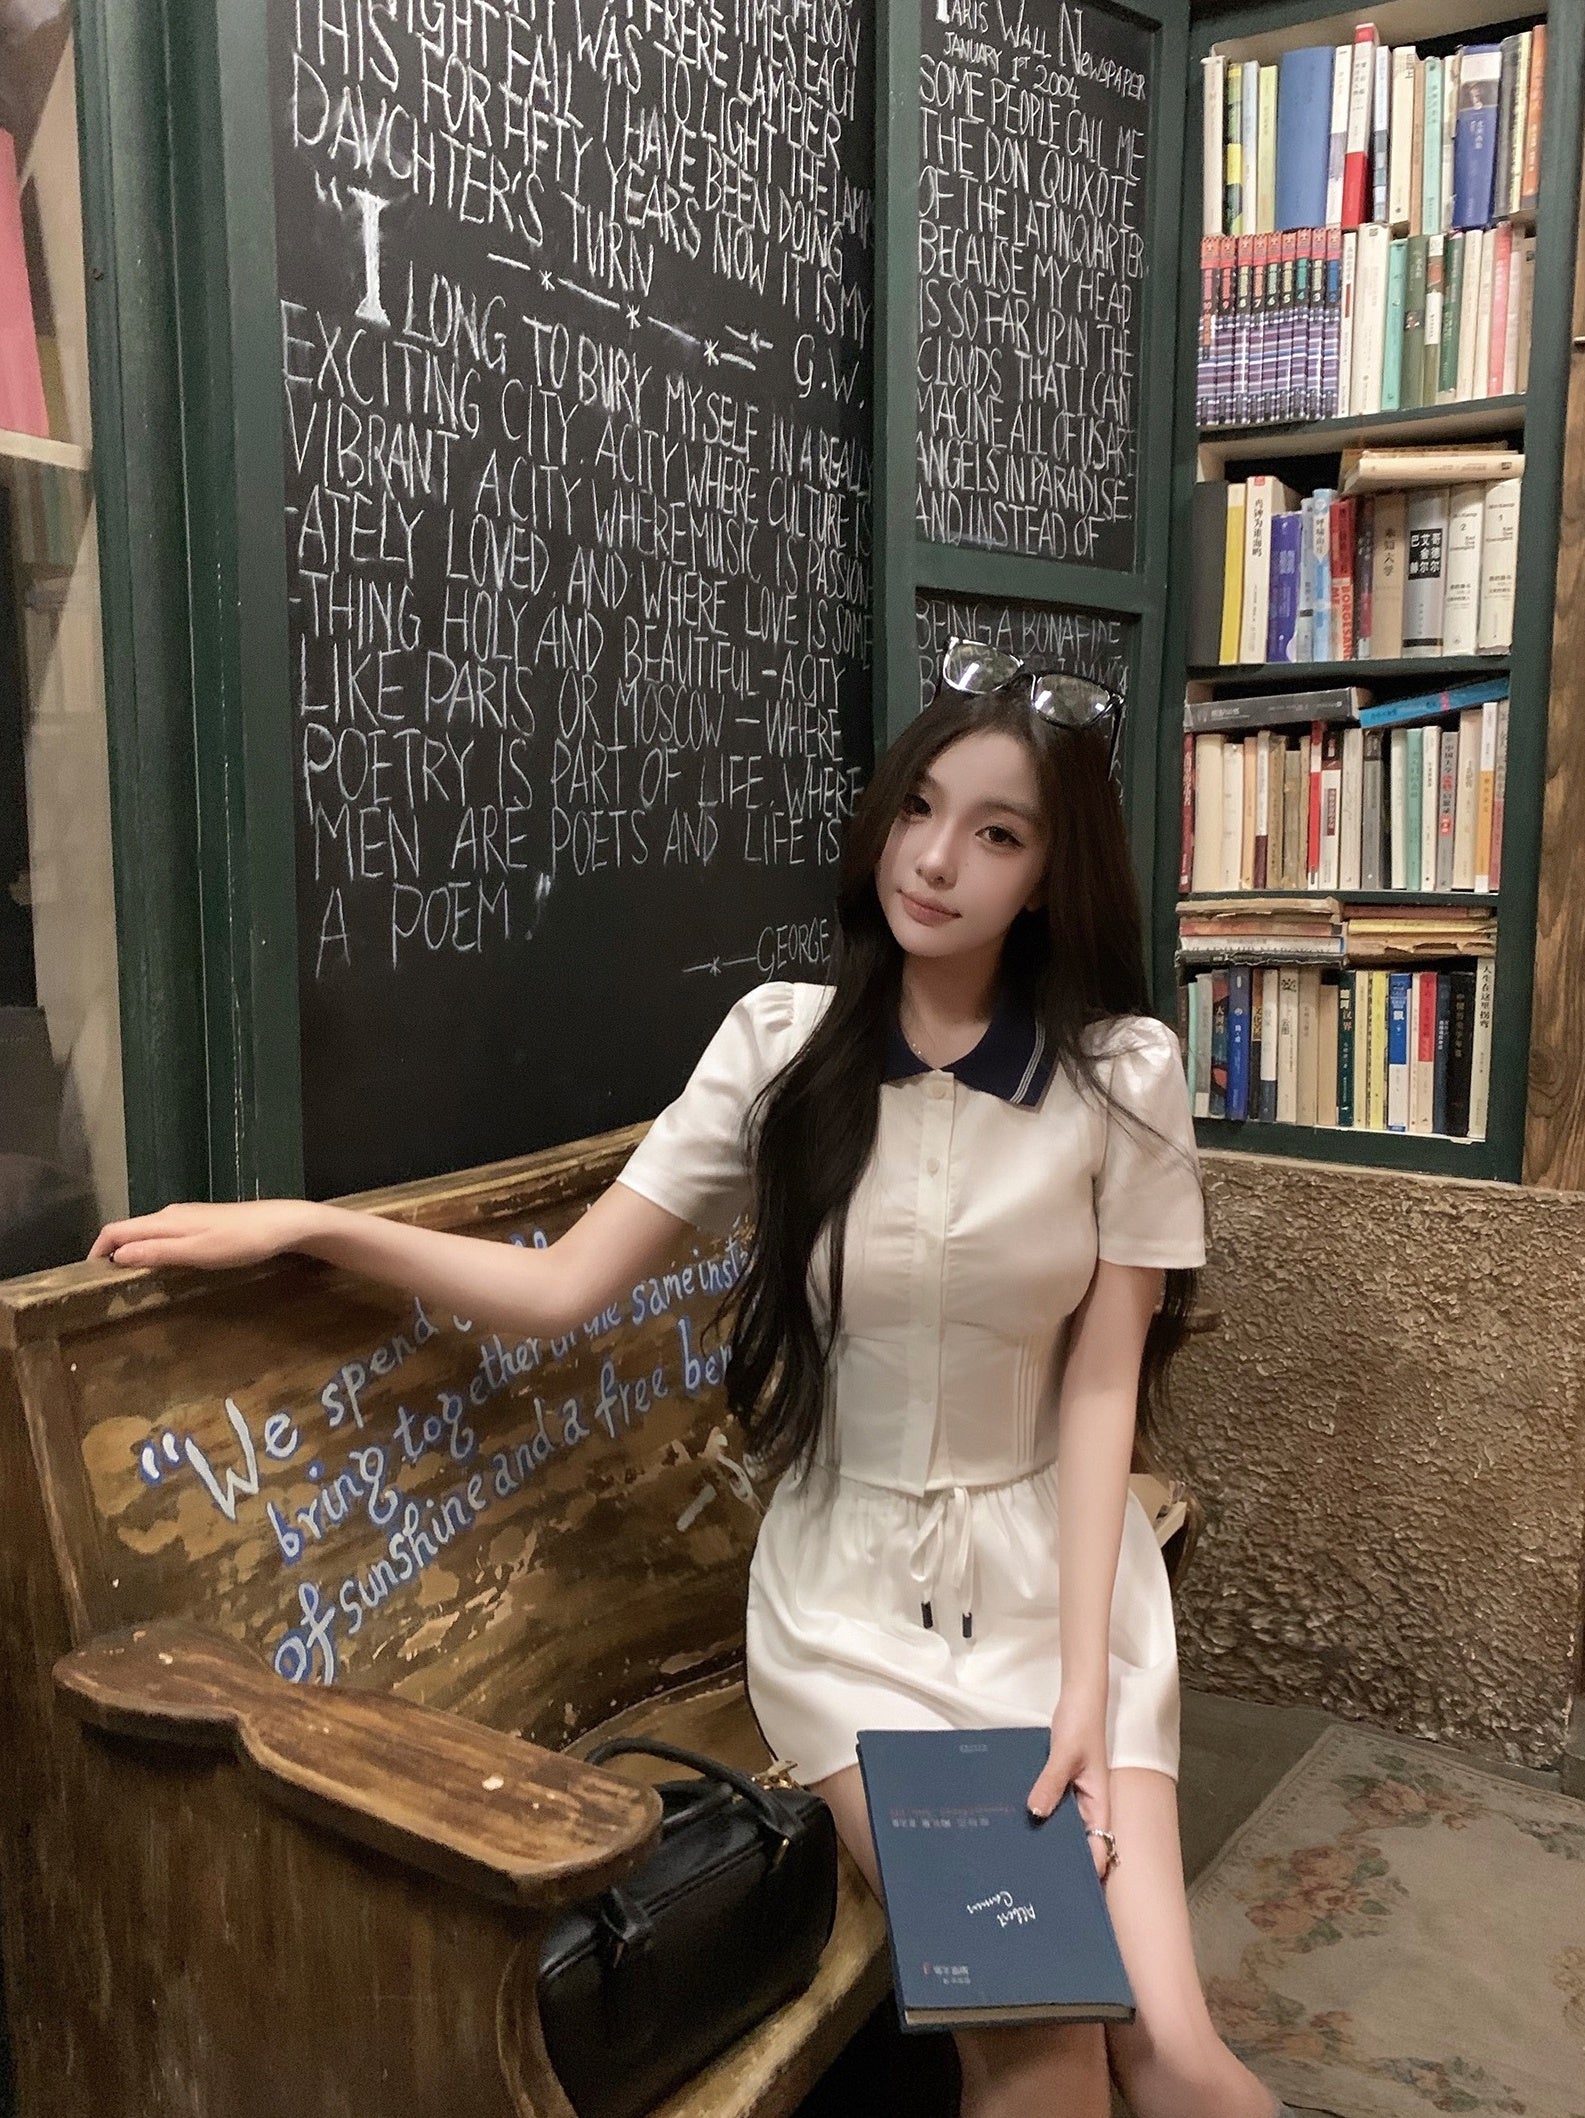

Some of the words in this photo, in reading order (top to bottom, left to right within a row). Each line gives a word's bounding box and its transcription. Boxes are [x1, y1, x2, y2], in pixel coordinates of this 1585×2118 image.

[574, 0, 643, 94] WAS
[654, 41, 691, 124] TO
[701, 80, 778, 184] LIGHT
[920, 54, 985, 123] SOME
[990, 77, 1060, 150] PEOPLE
[1116, 125, 1145, 181] ME
[943, 31, 1003, 74] JANUARY
[1033, 64, 1081, 108] 2004
[415, 32, 492, 147] FOR
[605, 147, 701, 260] YEARS
[713, 212, 769, 296] NOW
[782, 251, 806, 320] IT
[623, 90, 697, 193] HAVE
[706, 143, 770, 235] BEEN
[918, 165, 954, 219] OF
[960, 174, 1009, 241] THE
[920, 106, 974, 176] THE
[984, 126, 1029, 194] DON
[1040, 149, 1137, 230] QUIXOTE
[559, 190, 654, 297] TURN
[919, 218, 1027, 296] BECAUSE
[1033, 253, 1071, 309] MY
[1078, 268, 1132, 329] HEAD
[402, 260, 507, 376] LONG
[522, 314, 570, 389] TO
[578, 333, 653, 429] BURY
[771, 413, 795, 476] IN
[916, 336, 1003, 397] CLOUDS
[1014, 349, 1071, 410] THAT
[1090, 371, 1132, 426] CAN
[919, 278, 942, 333] IS
[947, 279, 978, 341] SO
[985, 290, 1030, 350] FAR
[1096, 324, 1134, 377] THE
[280, 299, 481, 440] EXCITING
[684, 442, 760, 525] WHERE
[768, 476, 850, 550] CULTURE
[1006, 455, 1025, 503] IN
[1010, 404, 1047, 456] ALL
[285, 378, 460, 506] VIBRANT
[509, 456, 582, 535] CITY
[592, 479, 686, 566] WHERE
[688, 503, 762, 584] MUSIC
[776, 533, 799, 596] IS
[1073, 516, 1105, 559] OF
[442, 585, 529, 669] HOLY
[535, 604, 604, 673] AND
[624, 616, 760, 696] BEAUTIFUL
[642, 561, 728, 635] WHERE
[745, 580, 799, 645] LOVE
[807, 597, 828, 654] IS
[300, 632, 405, 726] LIKE
[425, 649, 536, 738] PARIS
[557, 665, 600, 740] OR
[614, 677, 726, 752] MOSCOW
[765, 700, 844, 762] WHERE
[303, 723, 475, 825] POETRY
[499, 733, 534, 809] IS
[550, 737, 628, 805] PART
[639, 748, 682, 809] OF
[783, 757, 866, 820] WHERE
[314, 801, 420, 883] MEN
[451, 804, 528, 874] ARE
[551, 805, 649, 877] POETS
[663, 808, 719, 867] AND
[744, 811, 805, 866] LIFE
[818, 818, 842, 866] IS
[315, 886, 351, 980] A
[756, 916, 831, 981] GEORGE
[265, 1445, 399, 1563] bring
[631, 1266, 695, 1326] same
[321, 1296, 439, 1429] spend
[339, 1473, 486, 1634] sunshine
[494, 1398, 554, 1496] and
[562, 1399, 590, 1446] a
[594, 1360, 669, 1439] free
